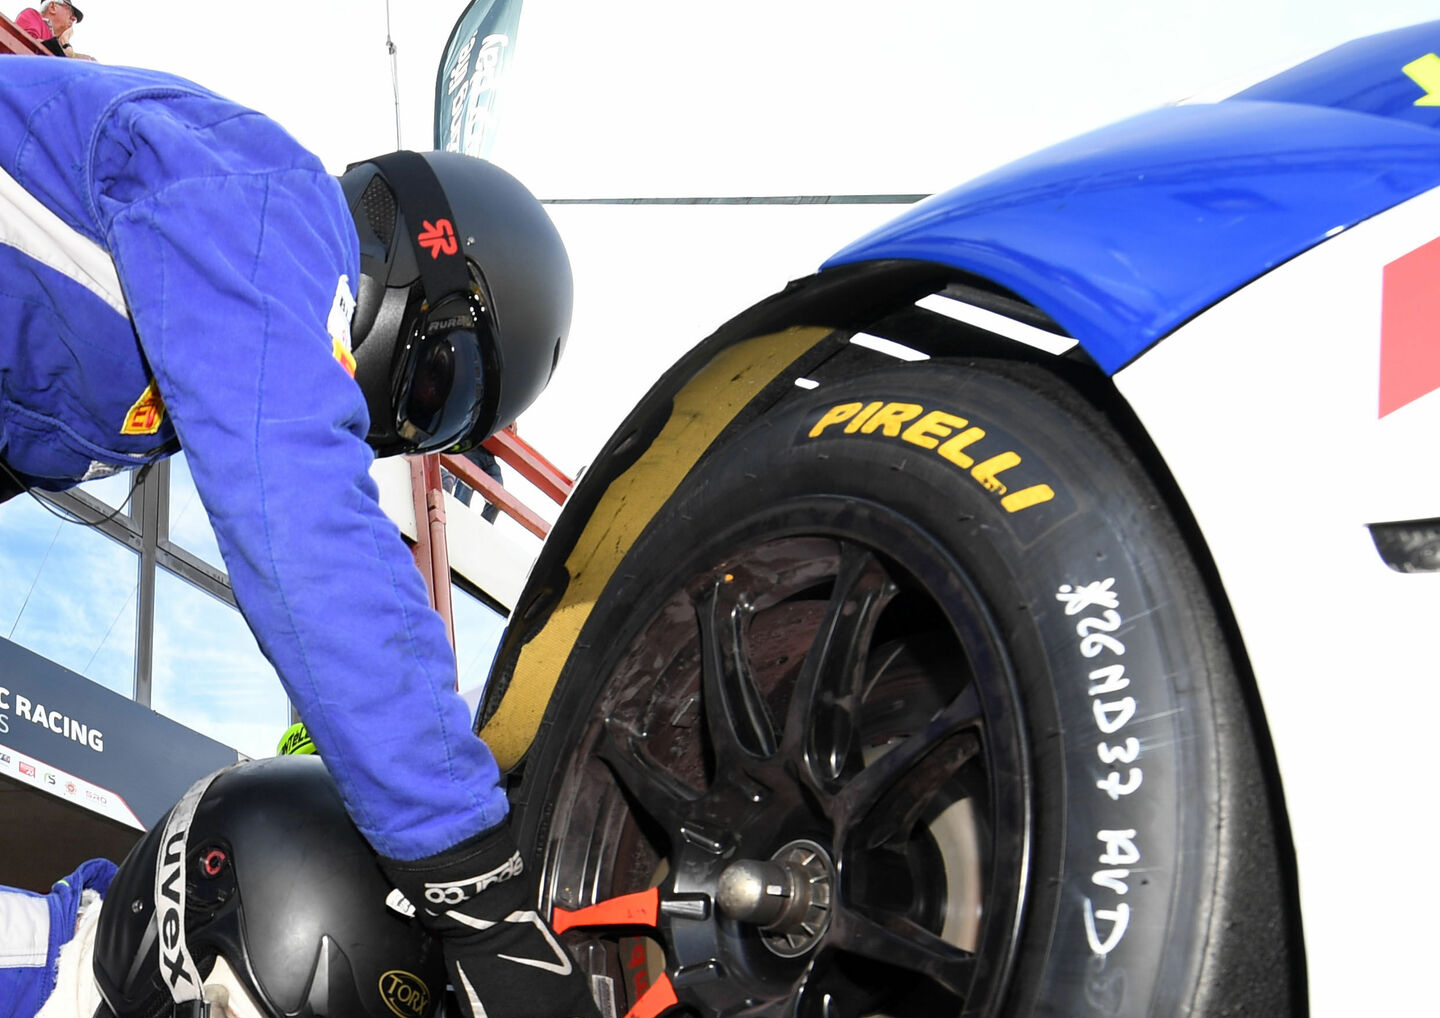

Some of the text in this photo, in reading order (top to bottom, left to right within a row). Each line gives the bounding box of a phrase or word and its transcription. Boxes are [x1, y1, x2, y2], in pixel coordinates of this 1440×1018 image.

[809, 402, 1055, 513] PIRELLI
[16, 695, 104, 752] RACING
[161, 830, 193, 989] uvex
[387, 975, 428, 1017] TORX
